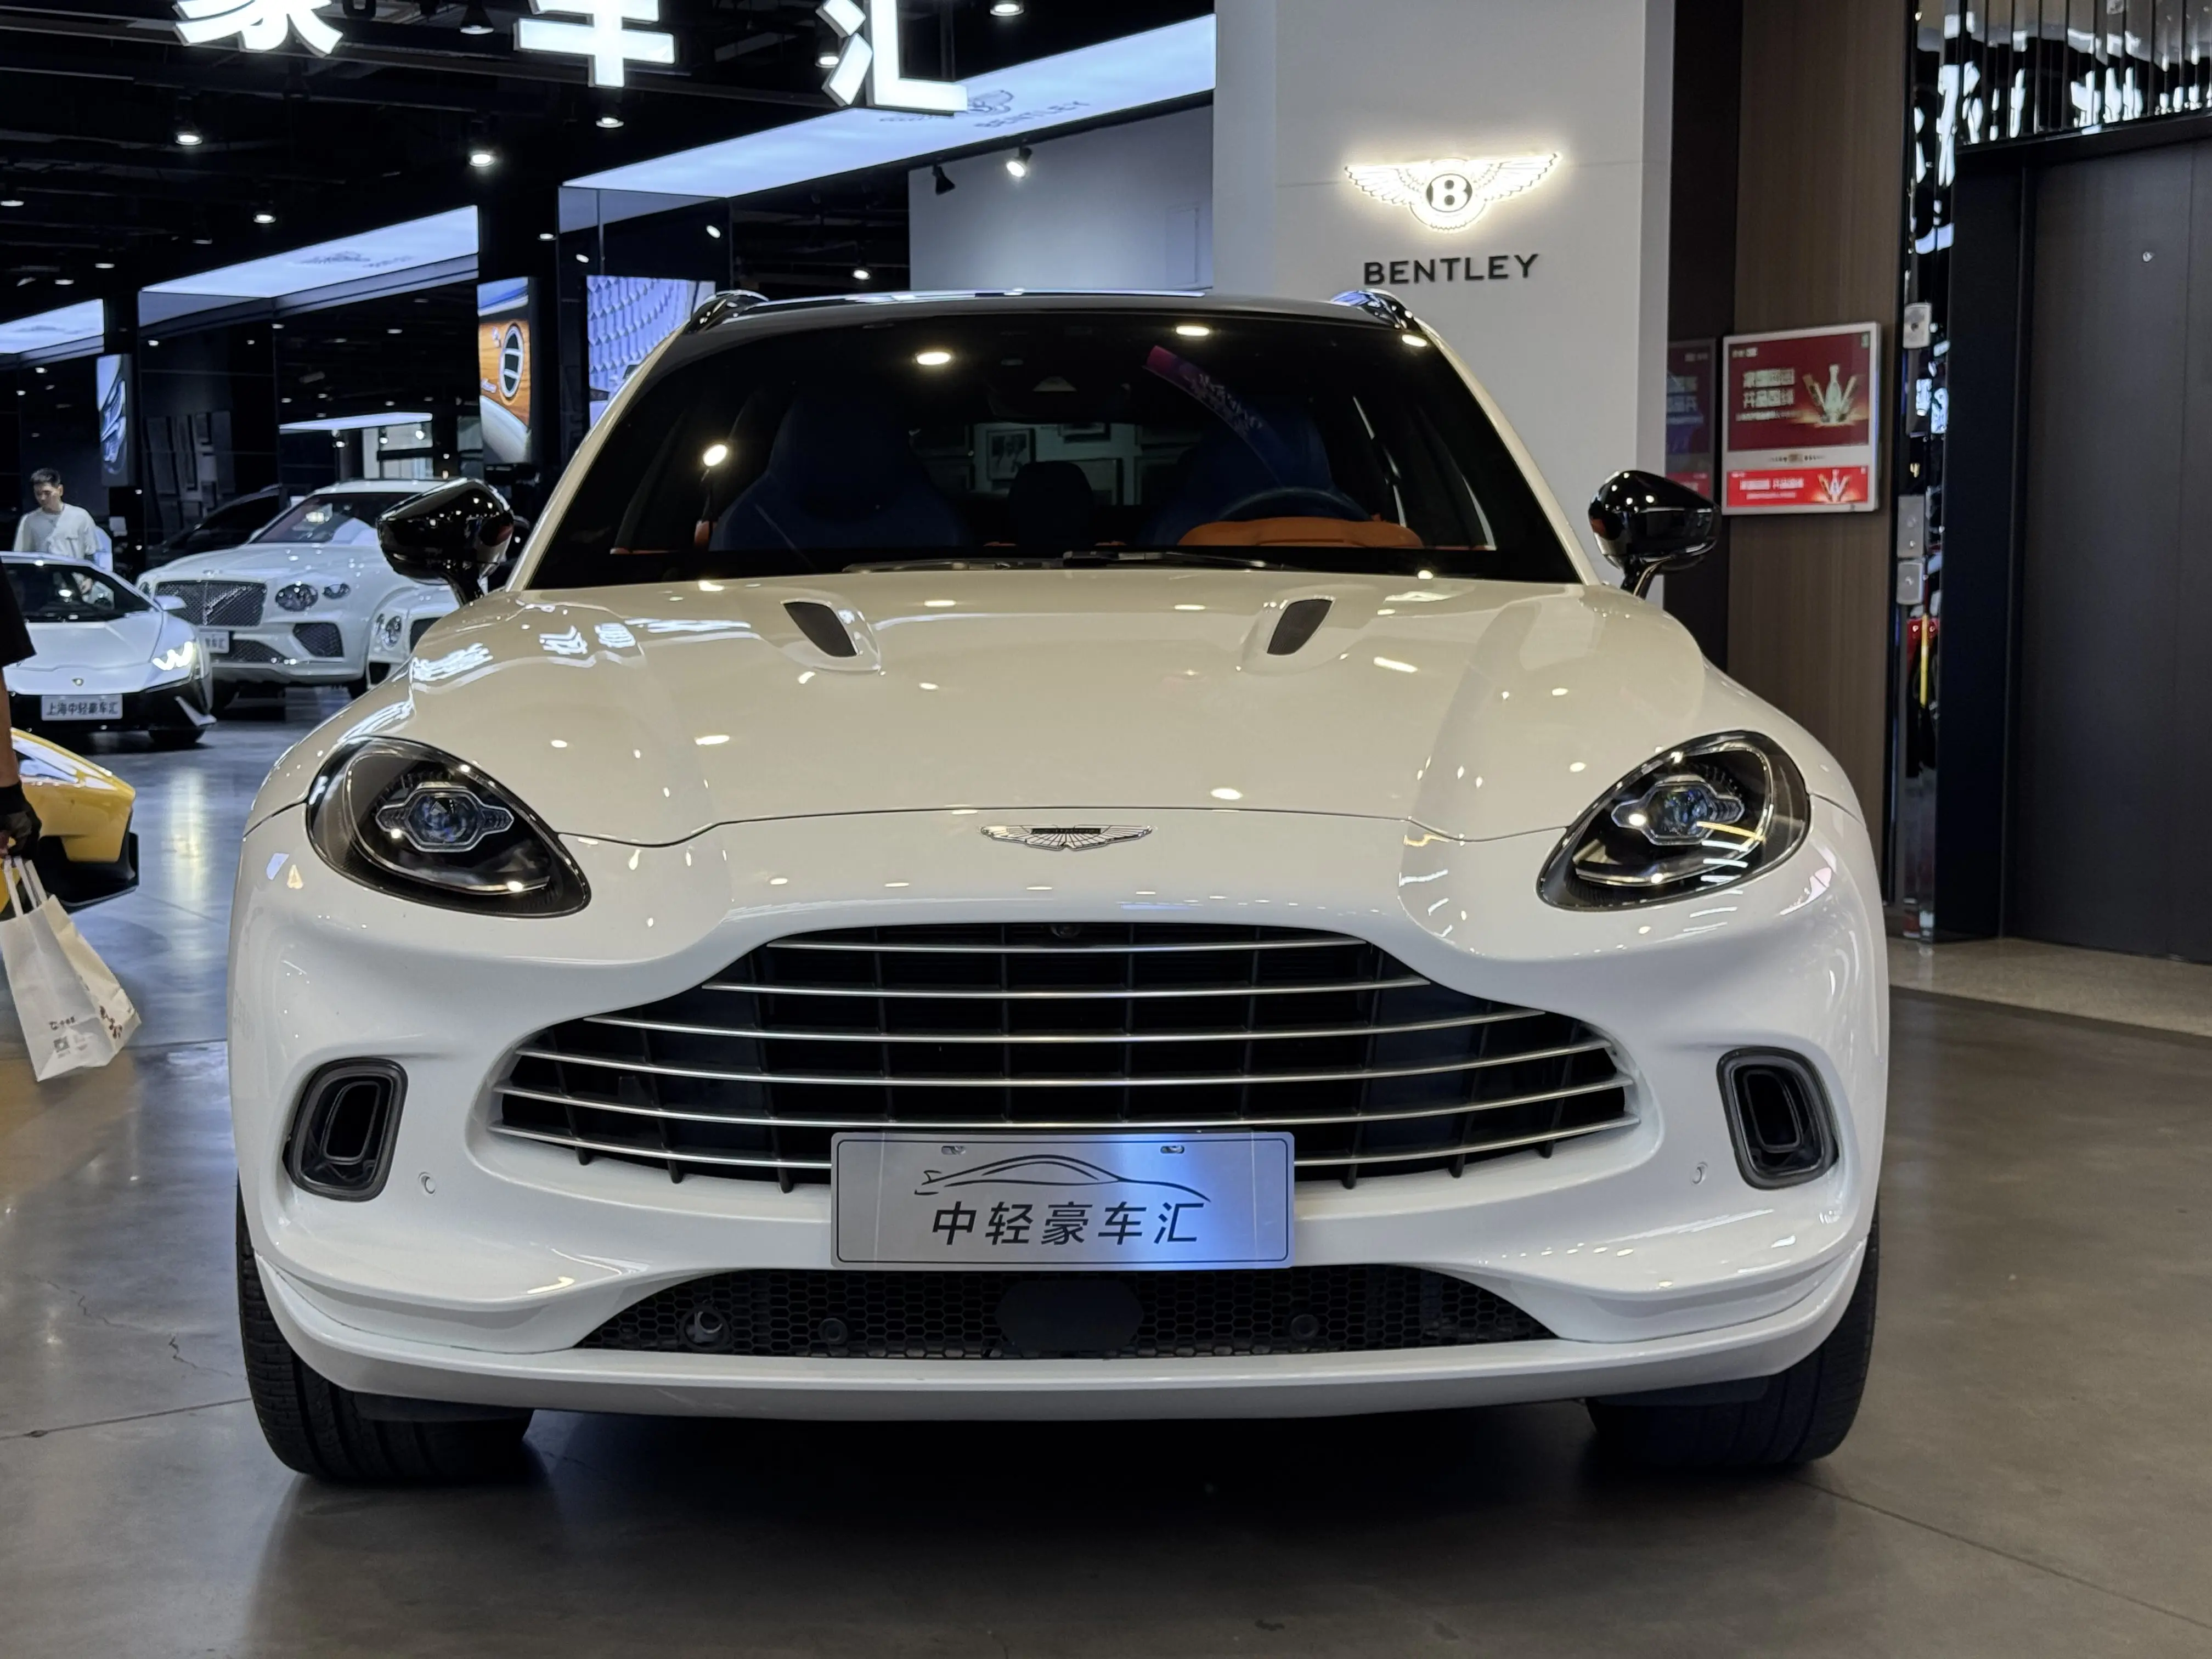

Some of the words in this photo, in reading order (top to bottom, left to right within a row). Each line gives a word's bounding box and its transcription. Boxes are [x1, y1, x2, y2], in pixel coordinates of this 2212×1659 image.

[1364, 253, 1539, 286] BENTLEY
[931, 1200, 1204, 1246] 中轻豪车汇
